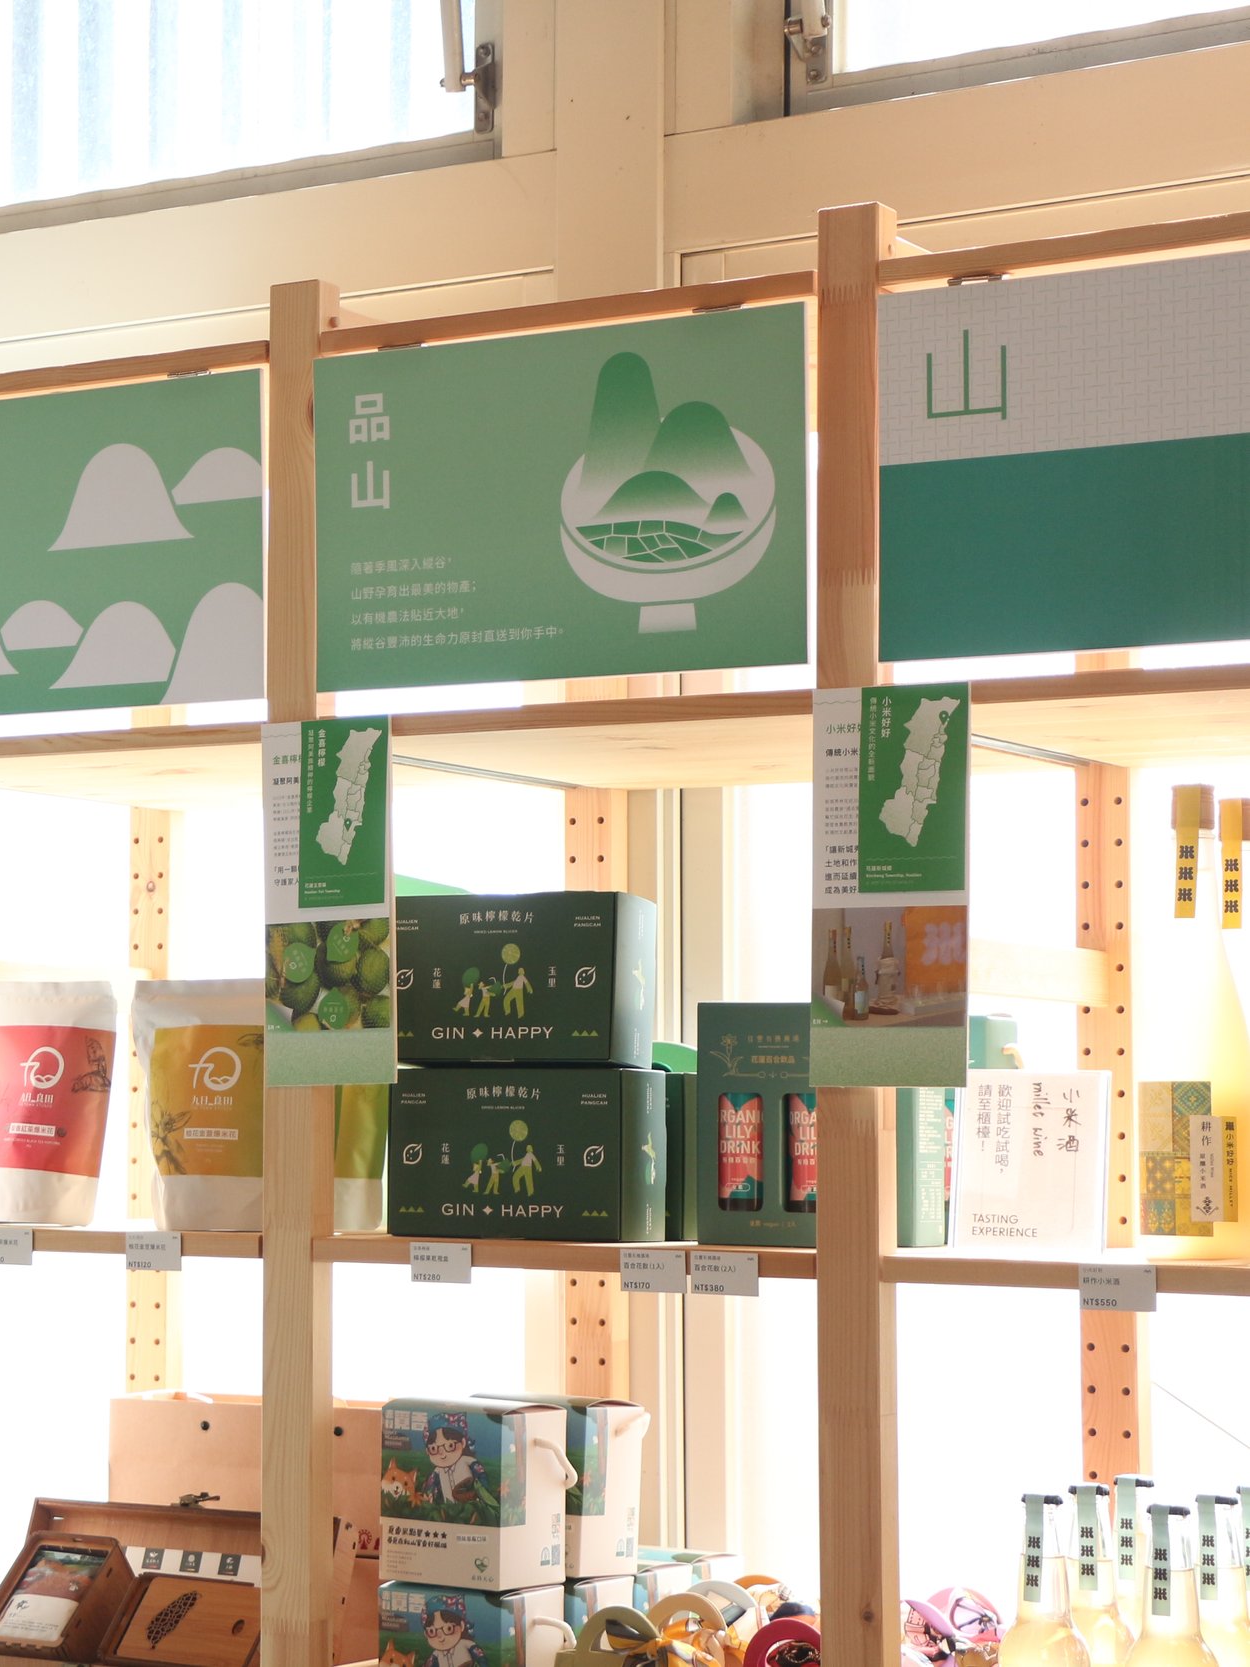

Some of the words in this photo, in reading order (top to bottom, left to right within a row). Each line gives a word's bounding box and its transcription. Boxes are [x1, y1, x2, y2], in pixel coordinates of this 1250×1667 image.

[926, 329, 1007, 420] 山
[350, 393, 390, 509] 品山
[881, 696, 892, 738] 小米好好
[318, 729, 326, 767] 金喜檸檬
[459, 910, 534, 924] 原味檸檬乾片
[431, 1027, 465, 1040] GIN
[491, 1027, 553, 1039] HAPPY
[466, 1085, 541, 1100] 原味檸檬乾片
[1033, 1082, 1050, 1118] millet
[718, 1109, 764, 1124] RGANI
[1056, 1088, 1081, 1153] 小米酒
[725, 1124, 753, 1139] LILY
[719, 1140, 761, 1154] DRINK
[441, 1203, 475, 1216] GIN
[502, 1204, 564, 1218] HAPPY
[972, 1213, 1018, 1224] TASTING
[972, 1227, 1037, 1237] EXPERIENCE
[413, 1273, 441, 1281] NT$280
[694, 1284, 725, 1292] NT$380
[1083, 1298, 1118, 1307] NT$550
